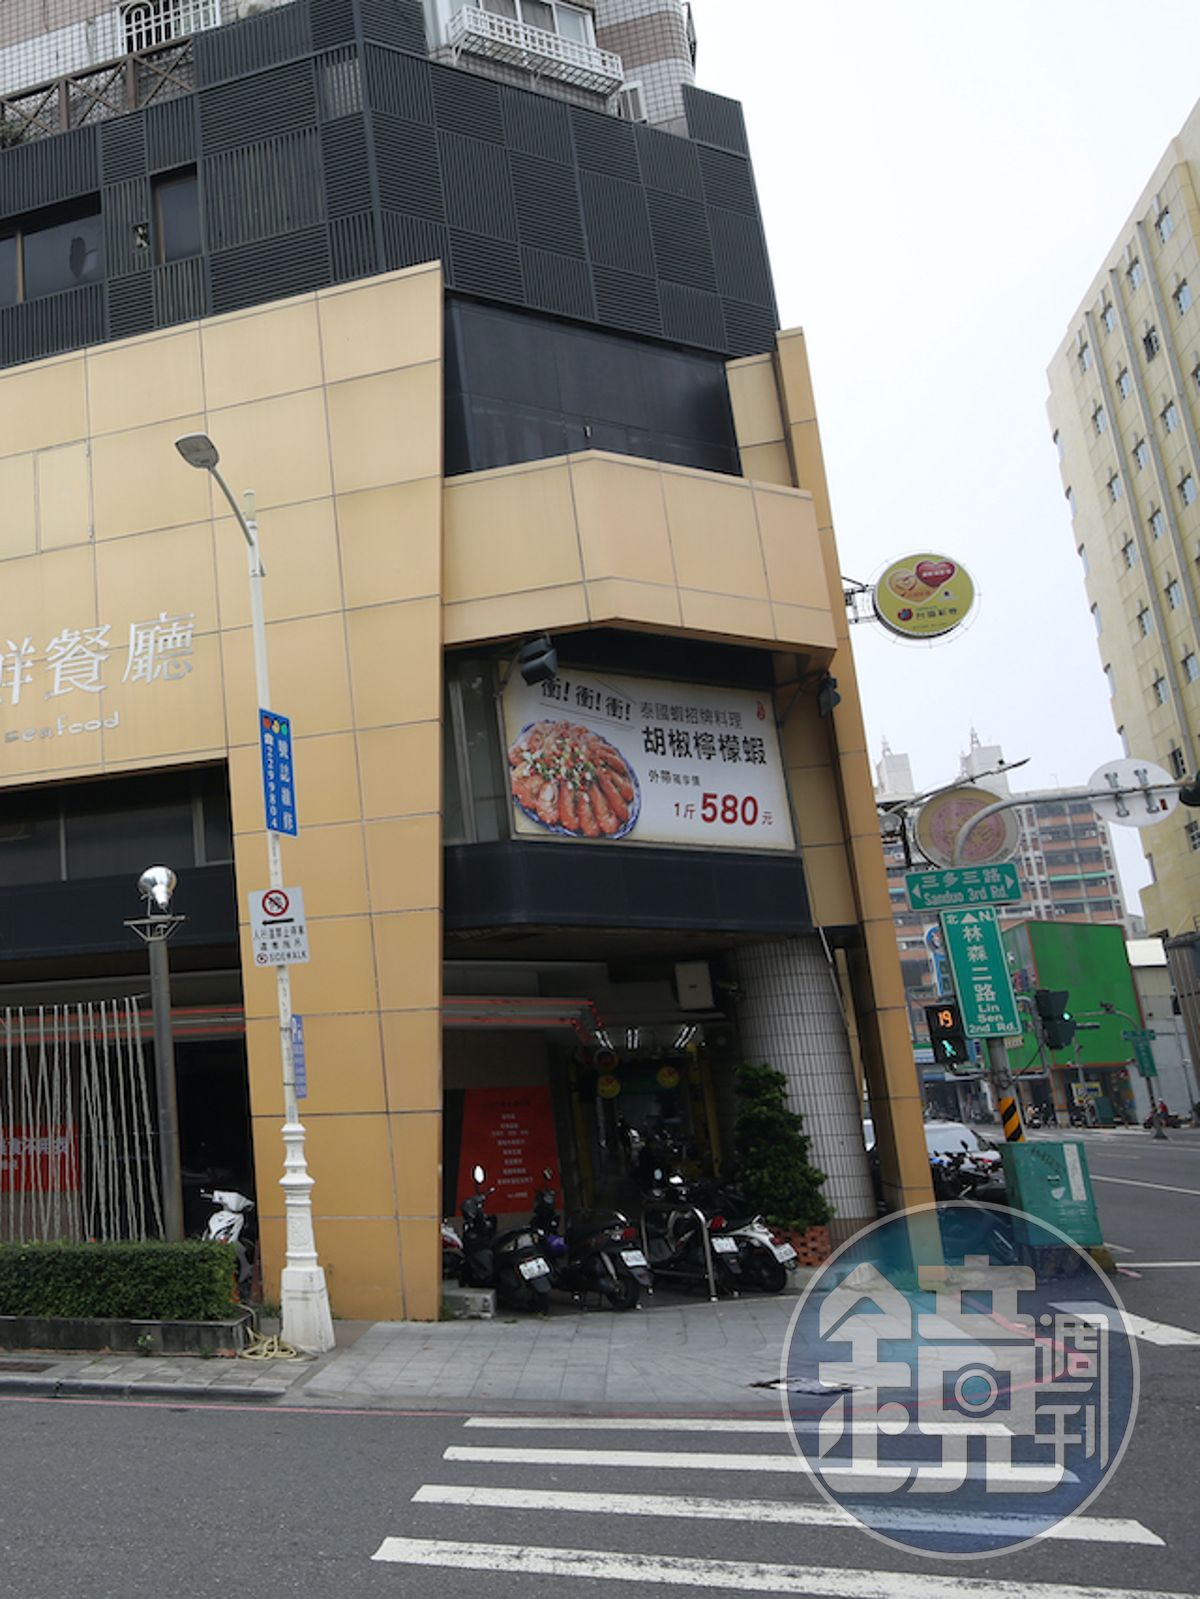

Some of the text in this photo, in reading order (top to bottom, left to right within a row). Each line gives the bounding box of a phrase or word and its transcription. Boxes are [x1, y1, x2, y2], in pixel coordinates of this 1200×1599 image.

[642, 726, 767, 765] 胡椒檸檬蝦
[921, 868, 1000, 889] 三多三路
[967, 887, 988, 902] 3rd
[990, 884, 1008, 899] Rd.
[946, 914, 959, 924] 北
[963, 924, 997, 1002] 林森二路
[978, 1004, 1000, 1013] Lin
[977, 1014, 1004, 1023] Sen
[968, 1022, 1018, 1034] 2nd Rd.
